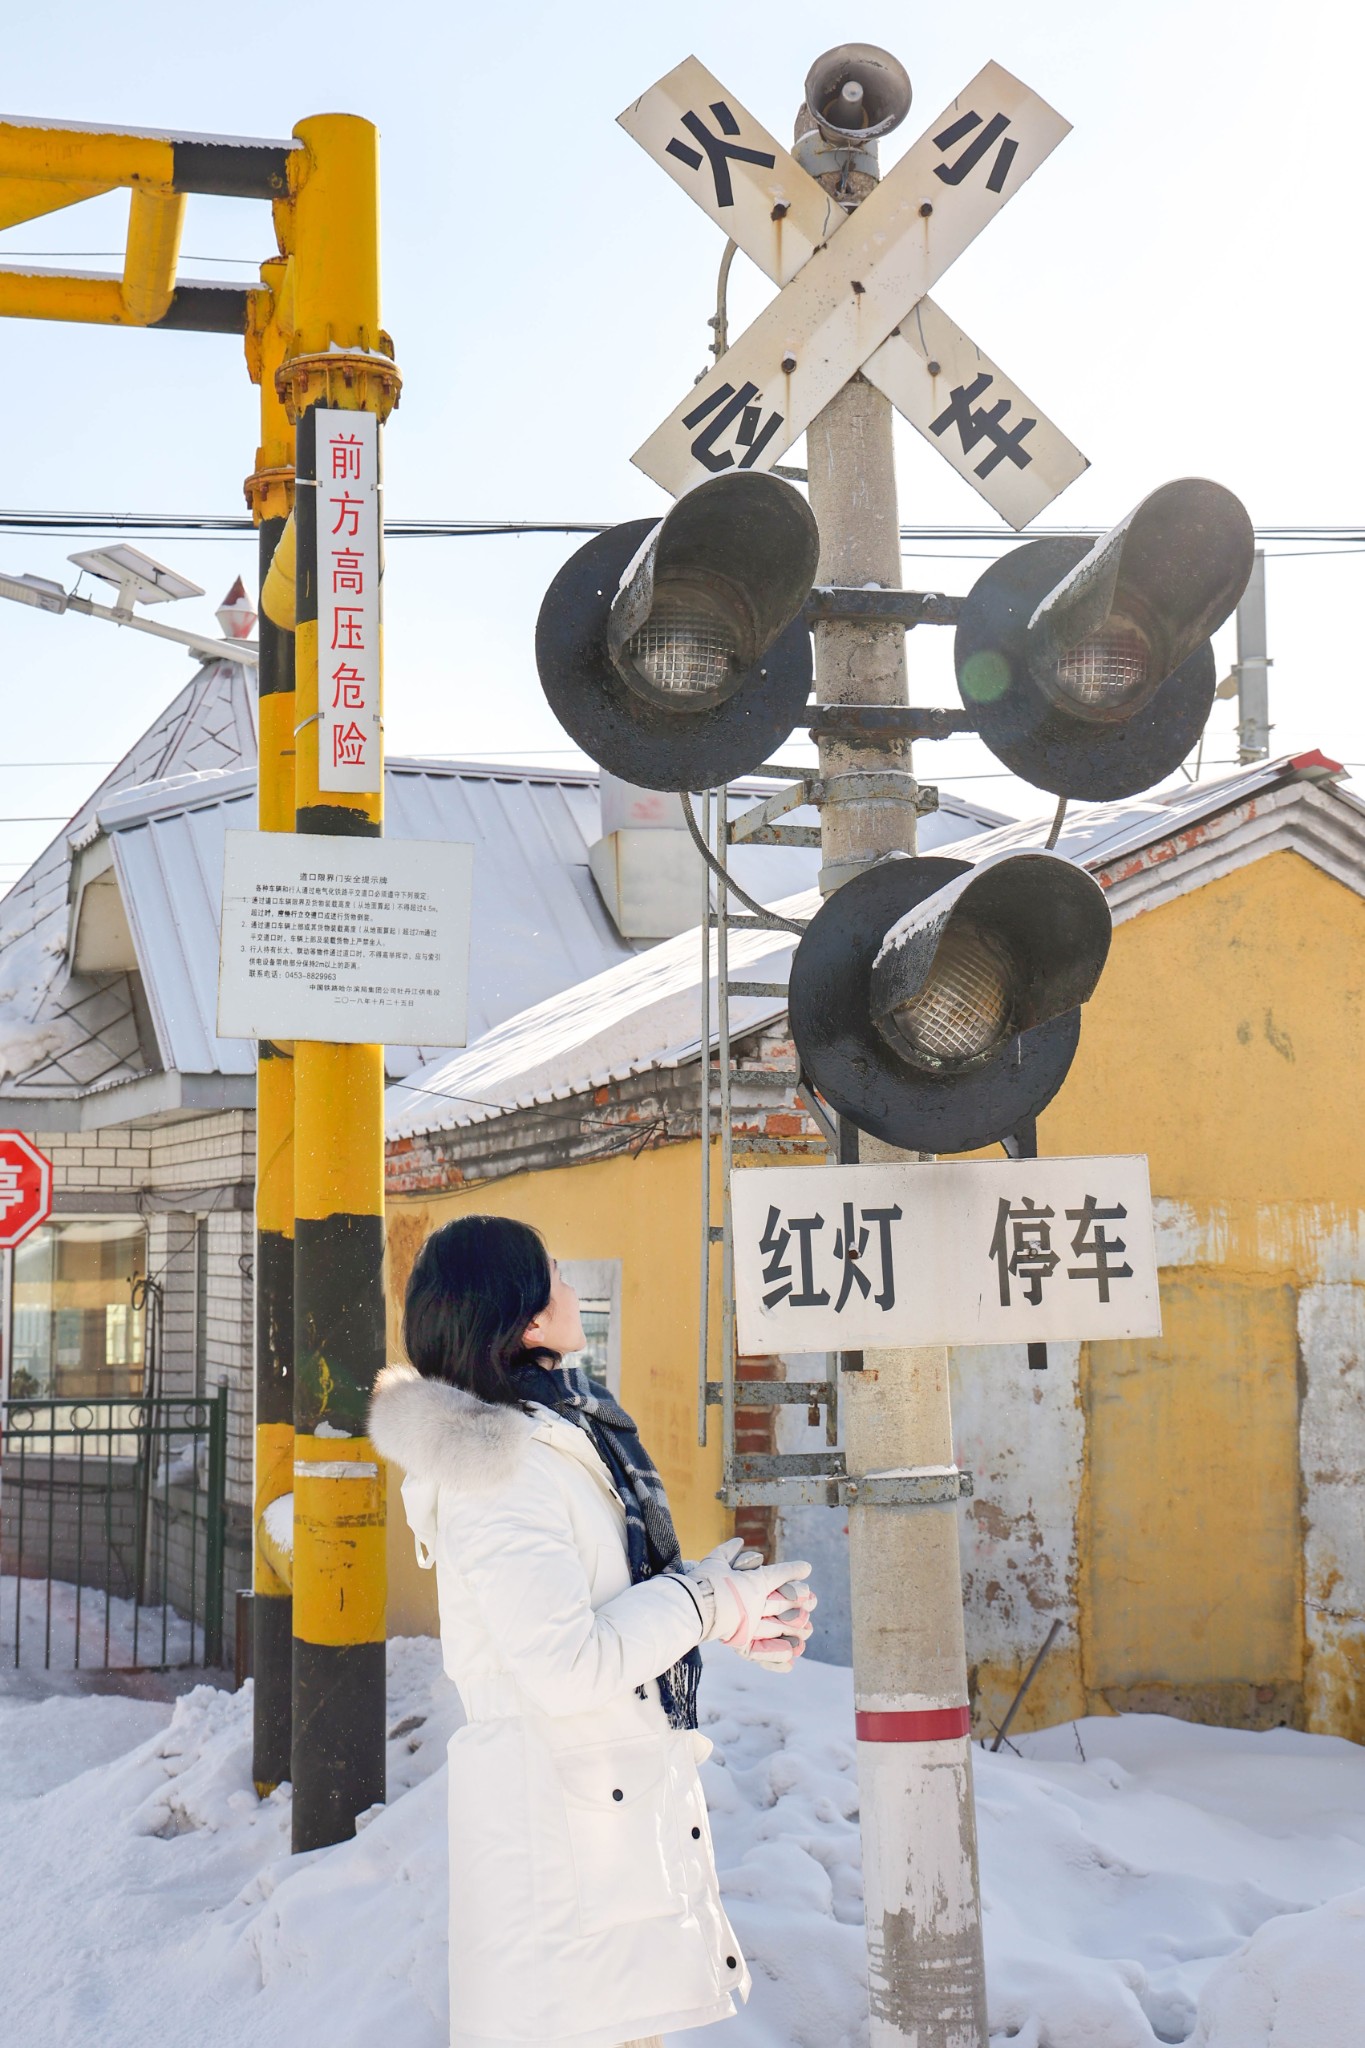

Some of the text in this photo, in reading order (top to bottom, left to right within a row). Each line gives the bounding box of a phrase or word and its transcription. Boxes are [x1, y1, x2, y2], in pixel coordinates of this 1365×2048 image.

[666, 101, 1036, 479] 火 车
[682, 111, 1019, 472] 小 心
[329, 433, 367, 767] 前方高压危险
[300, 872, 388, 885] 道口限界门安全提示牌
[759, 1195, 1134, 1314] 红灯 停车
